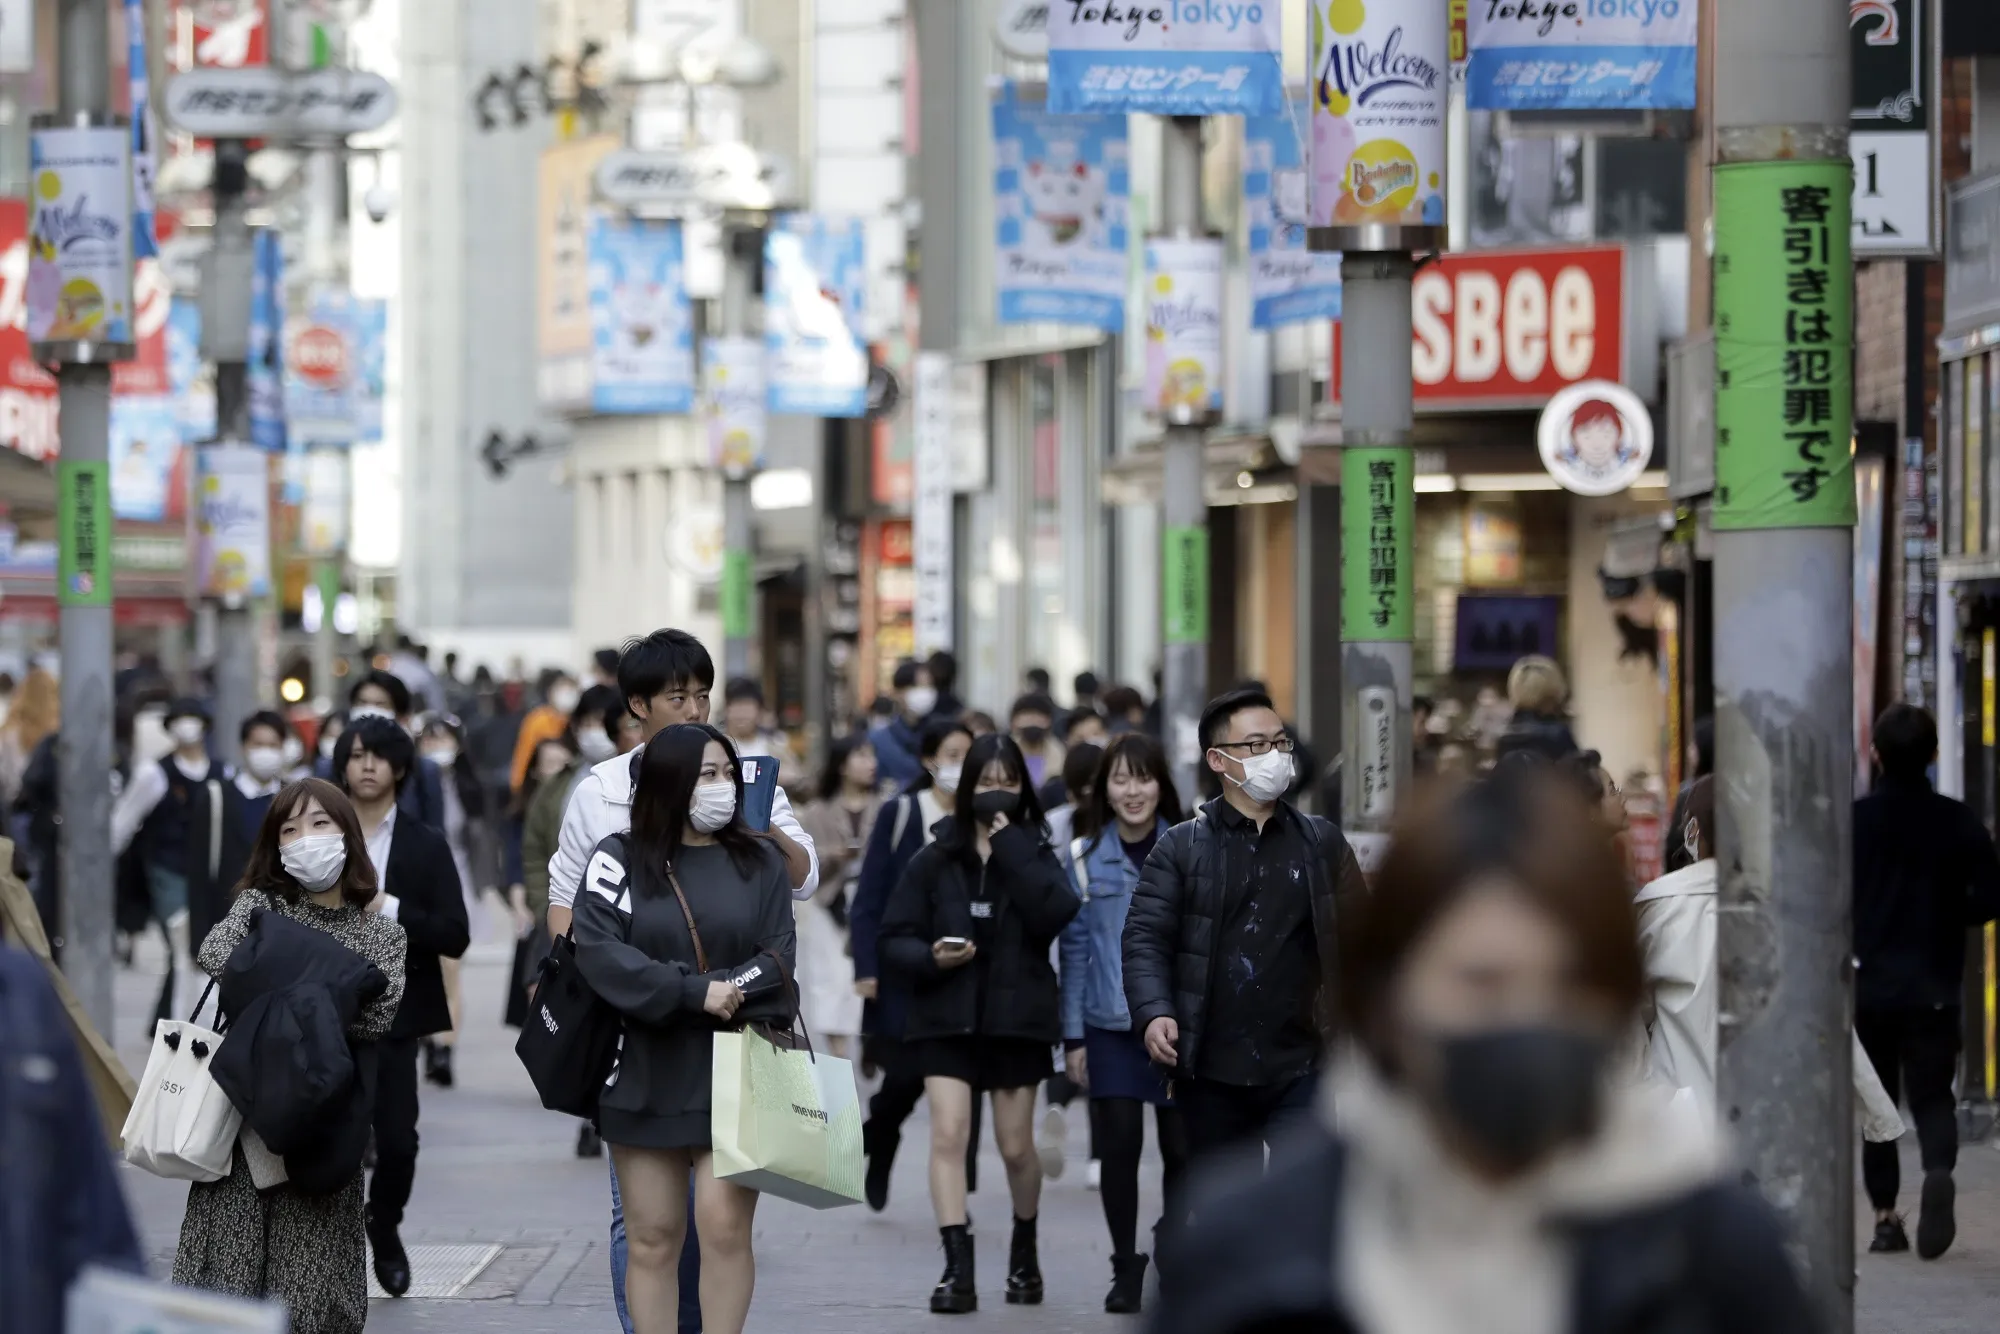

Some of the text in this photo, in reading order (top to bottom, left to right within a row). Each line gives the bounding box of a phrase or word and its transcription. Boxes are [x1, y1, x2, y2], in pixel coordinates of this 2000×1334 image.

[1071, 0, 1162, 41] Tokyo
[1171, 0, 1263, 32] Tokyo
[1486, 0, 1577, 38] Tokyo
[1586, 0, 1679, 27] Tokyo
[1319, 25, 1439, 106] Welcome
[1411, 265, 1596, 384] SBee
[1781, 185, 1832, 502] 客引きは犯罪です
[1368, 460, 1397, 628] 客引きは犯罪です
[726, 966, 762, 987] EMO
[541, 1004, 559, 1035] MOSSY
[792, 1103, 828, 1124] oneway
